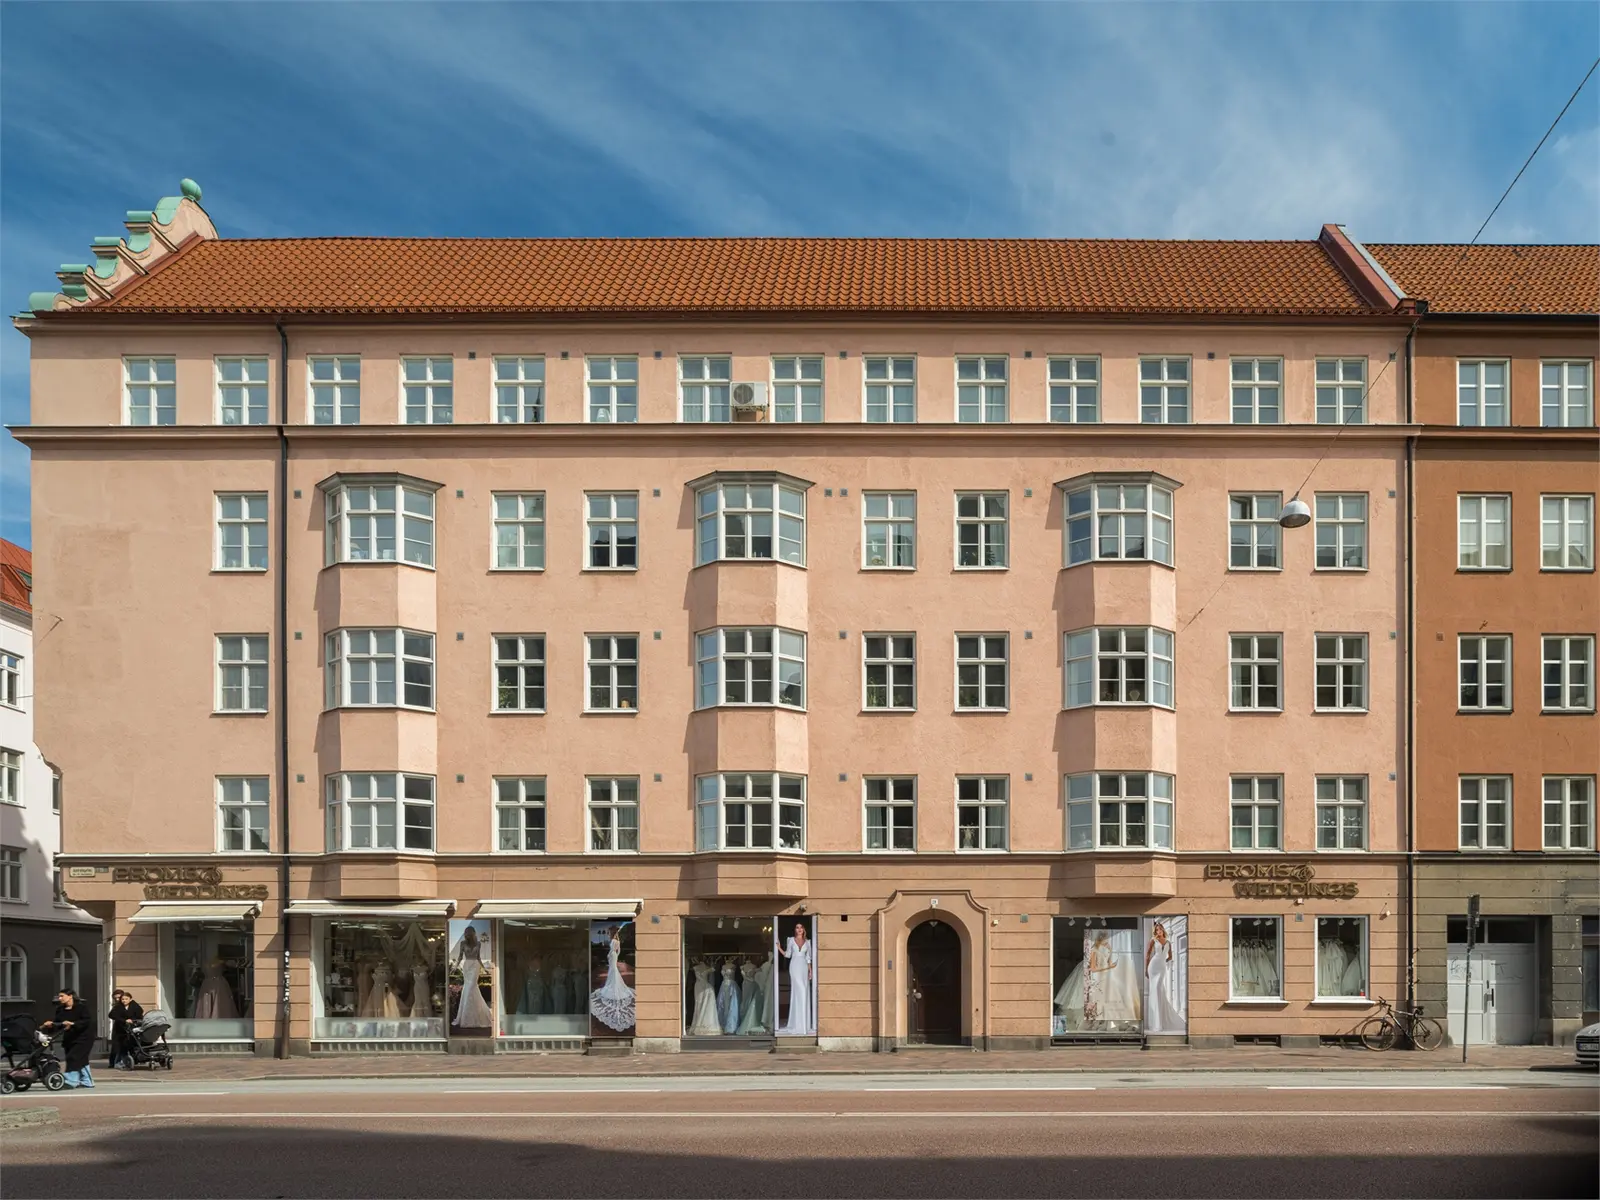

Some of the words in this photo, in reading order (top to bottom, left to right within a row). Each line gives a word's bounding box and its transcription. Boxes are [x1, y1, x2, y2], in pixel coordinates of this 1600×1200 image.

[114, 865, 202, 881] PROMS
[1206, 863, 1291, 879] PROMS
[145, 884, 268, 899] WEDDINGS
[1234, 882, 1358, 898] WEDDINGS
